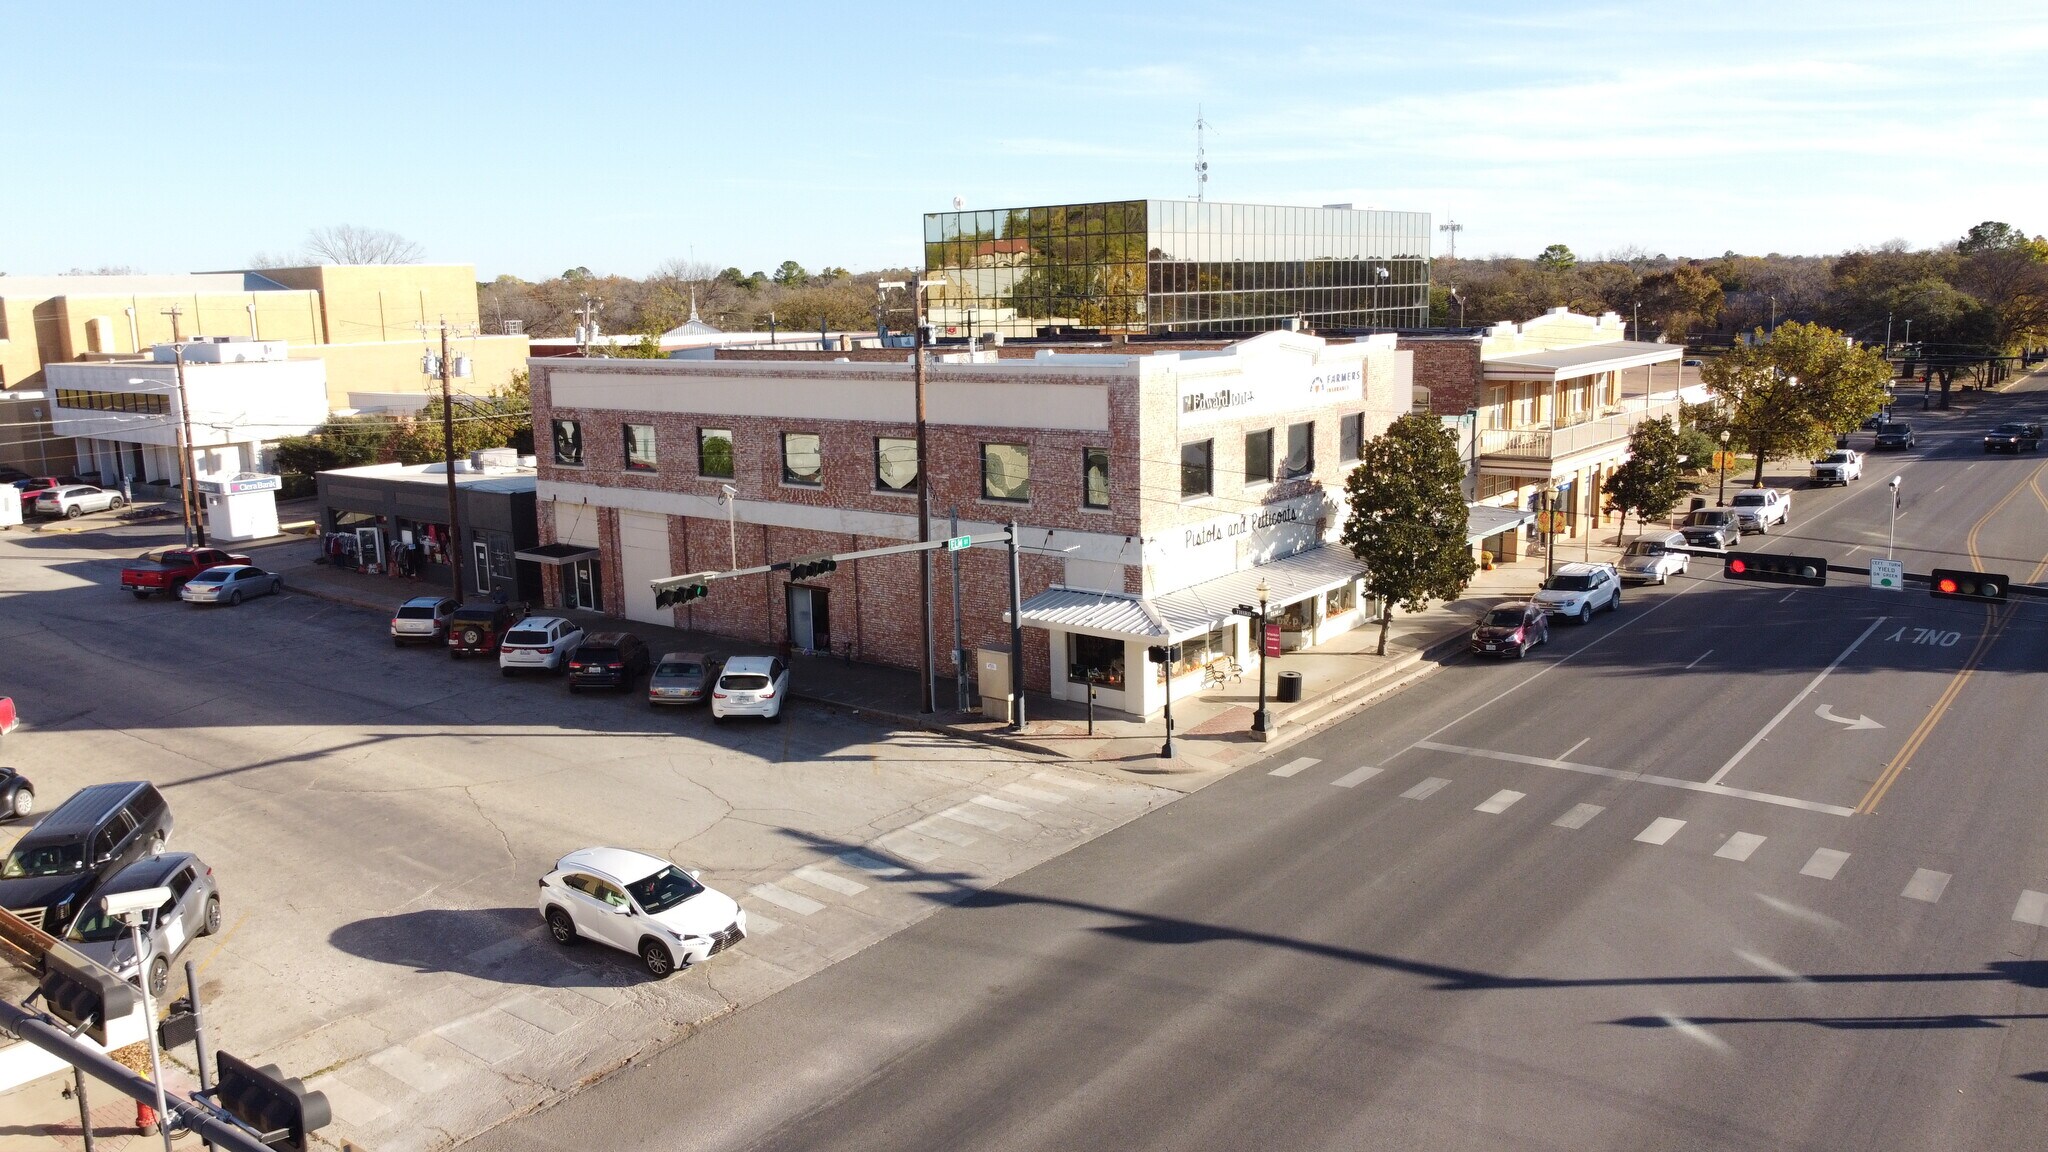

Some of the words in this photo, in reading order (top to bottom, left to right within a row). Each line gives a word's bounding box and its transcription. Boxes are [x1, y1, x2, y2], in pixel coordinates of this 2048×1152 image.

[1327, 371, 1360, 383] FARMERS
[1185, 523, 1223, 549] Pistols
[1227, 514, 1247, 537] and
[1251, 505, 1298, 531] Petticoats
[1885, 626, 1961, 647] ONLY
